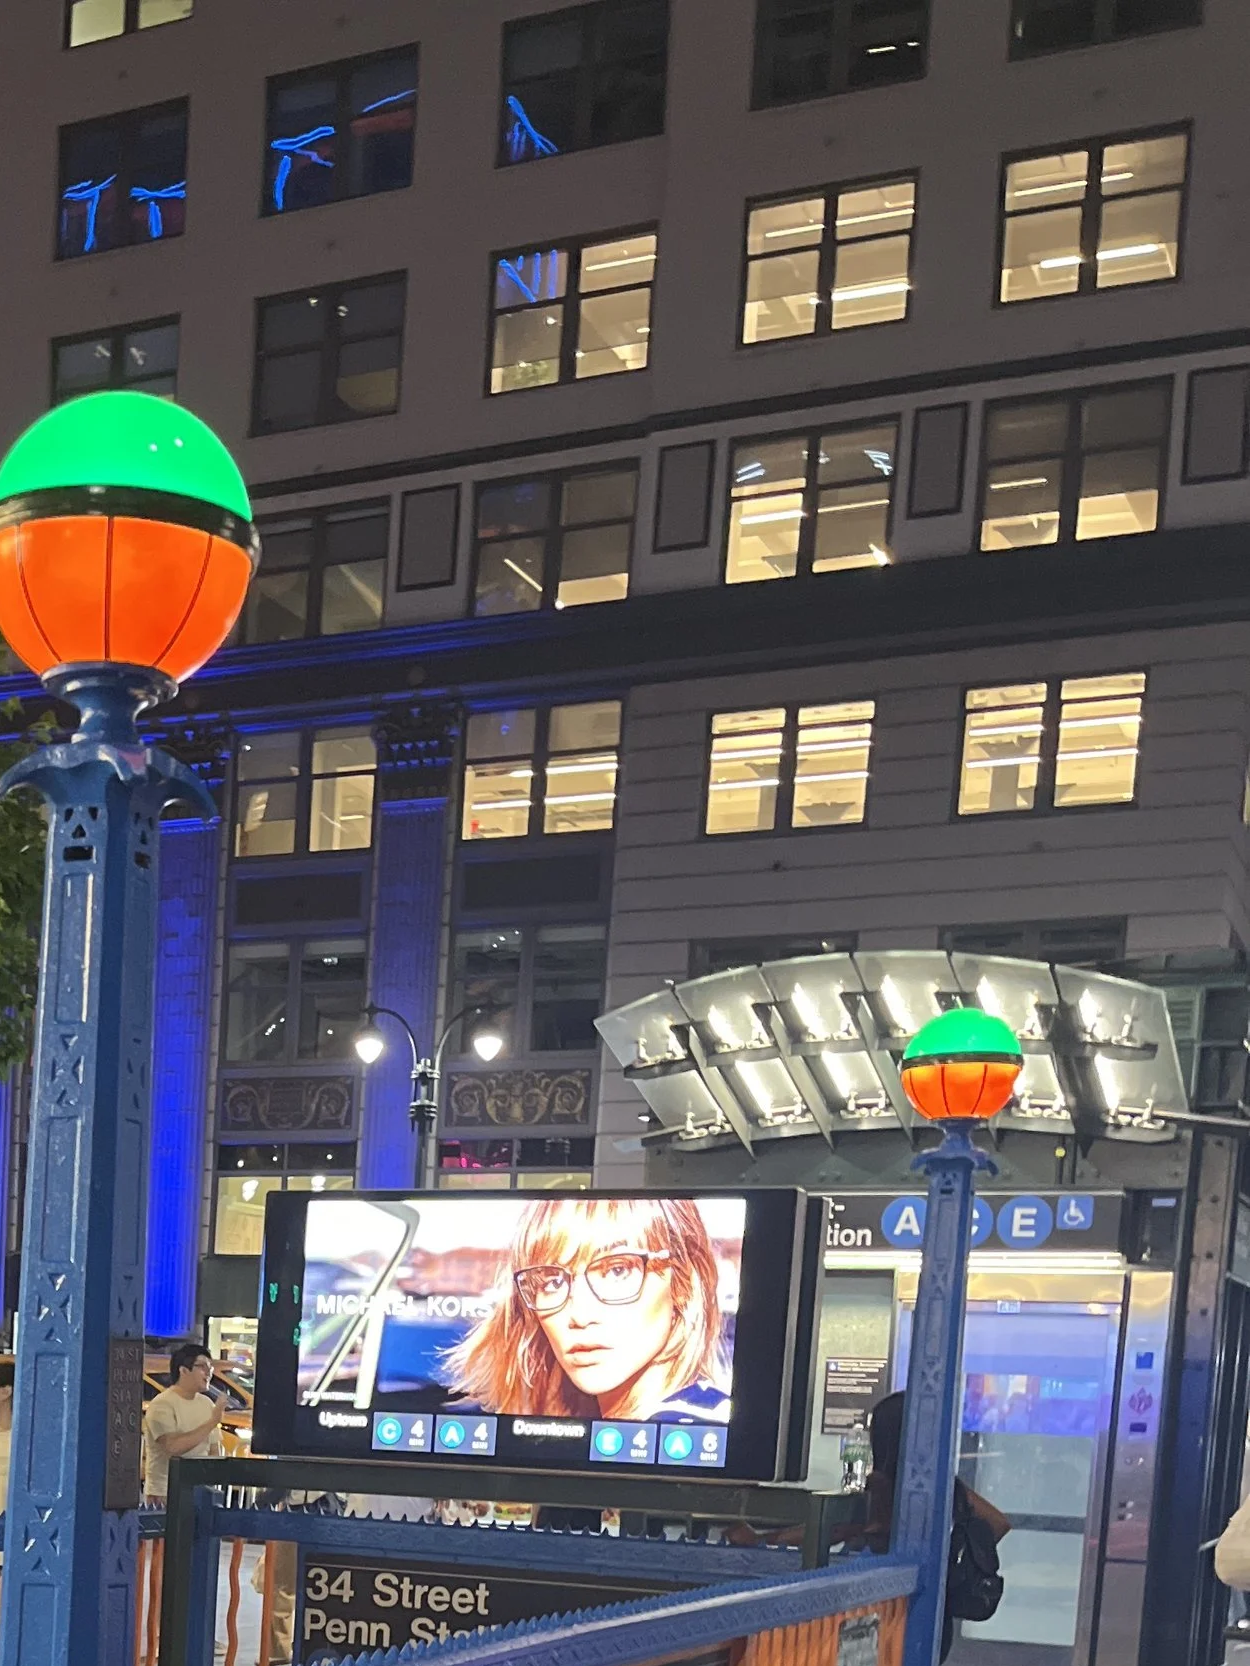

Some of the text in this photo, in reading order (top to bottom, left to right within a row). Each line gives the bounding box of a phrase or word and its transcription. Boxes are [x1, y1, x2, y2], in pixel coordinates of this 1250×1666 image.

[893, 1206, 920, 1236] A
[1011, 1207, 1038, 1237] E
[826, 1223, 872, 1246] tion
[316, 1295, 494, 1318] MICHAEL KORS
[319, 1412, 368, 1428] Uptown
[382, 1420, 424, 1438] C 4
[513, 1419, 585, 1438] Downtown
[444, 1422, 488, 1444] A 4
[602, 1429, 647, 1450] E 4
[670, 1433, 718, 1454] A 6
[306, 1567, 489, 1615] 34 Street
[304, 1607, 391, 1648] Penn
